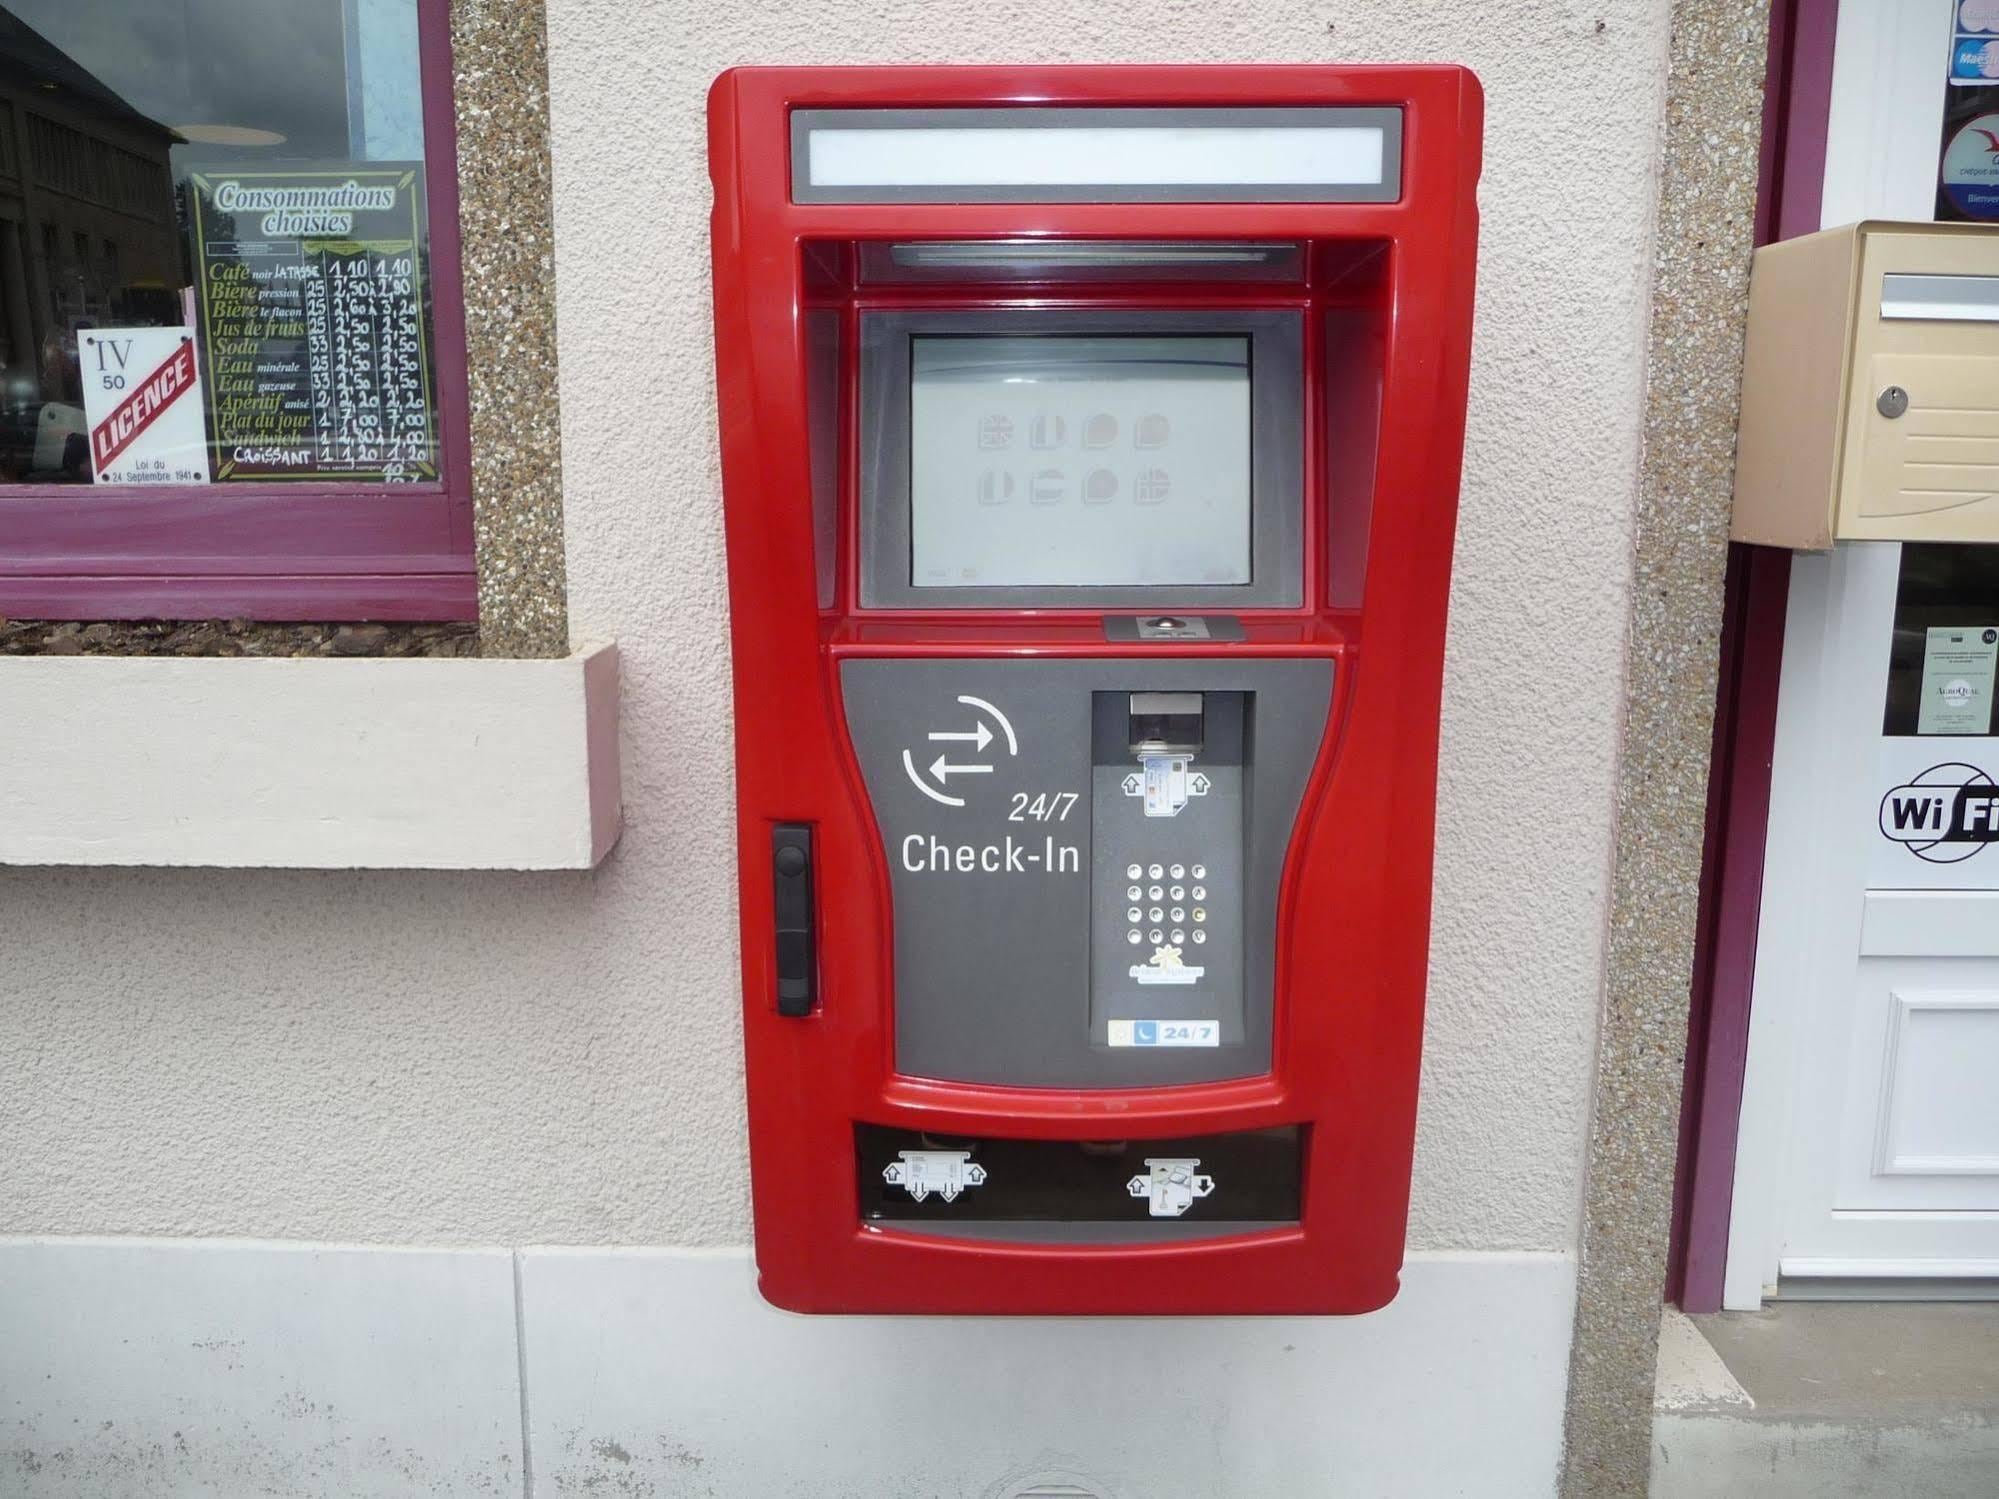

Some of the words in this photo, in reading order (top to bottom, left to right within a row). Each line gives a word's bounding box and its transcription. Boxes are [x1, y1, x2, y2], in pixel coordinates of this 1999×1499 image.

[216, 182, 395, 211] Consommations
[262, 210, 354, 235] choisies
[209, 262, 250, 280] Café
[252, 269, 273, 279] noir
[329, 260, 367, 284] 1,10
[376, 258, 411, 281] 1,10
[209, 281, 257, 299] Bière
[258, 288, 300, 301] pression
[307, 280, 325, 298] 25
[212, 301, 259, 318] Bière
[271, 306, 302, 319] flacon
[307, 298, 326, 316] 25
[213, 319, 240, 336] Jus
[244, 319, 261, 336] de
[263, 319, 305, 340] fruits
[308, 316, 326, 334] 25
[96, 339, 133, 371] IV
[214, 337, 258, 355] Soda
[310, 334, 328, 353] 33
[217, 356, 253, 373] Eau
[257, 362, 300, 372] minérale
[311, 355, 329, 372] 25
[103, 375, 126, 390] 50
[218, 375, 255, 392] Eau
[258, 382, 296, 393] gazeuse
[313, 371, 331, 390] 33
[98, 353, 189, 460] LICENCE
[219, 392, 285, 413] Apéritif
[284, 399, 310, 409] anisé
[221, 411, 252, 429] Plat
[255, 411, 274, 428] du
[278, 411, 311, 431] jour
[319, 412, 331, 427] 1
[222, 428, 301, 447] Sandwich
[135, 460, 149, 469] Loi
[154, 460, 165, 469] du
[112, 472, 123, 482] 24
[126, 471, 171, 483] Septembre
[175, 471, 192, 480] 1941
[1008, 792, 1080, 822] 24/7
[902, 834, 1080, 873] Check-In
[1164, 1027, 1211, 1040] 24/7
